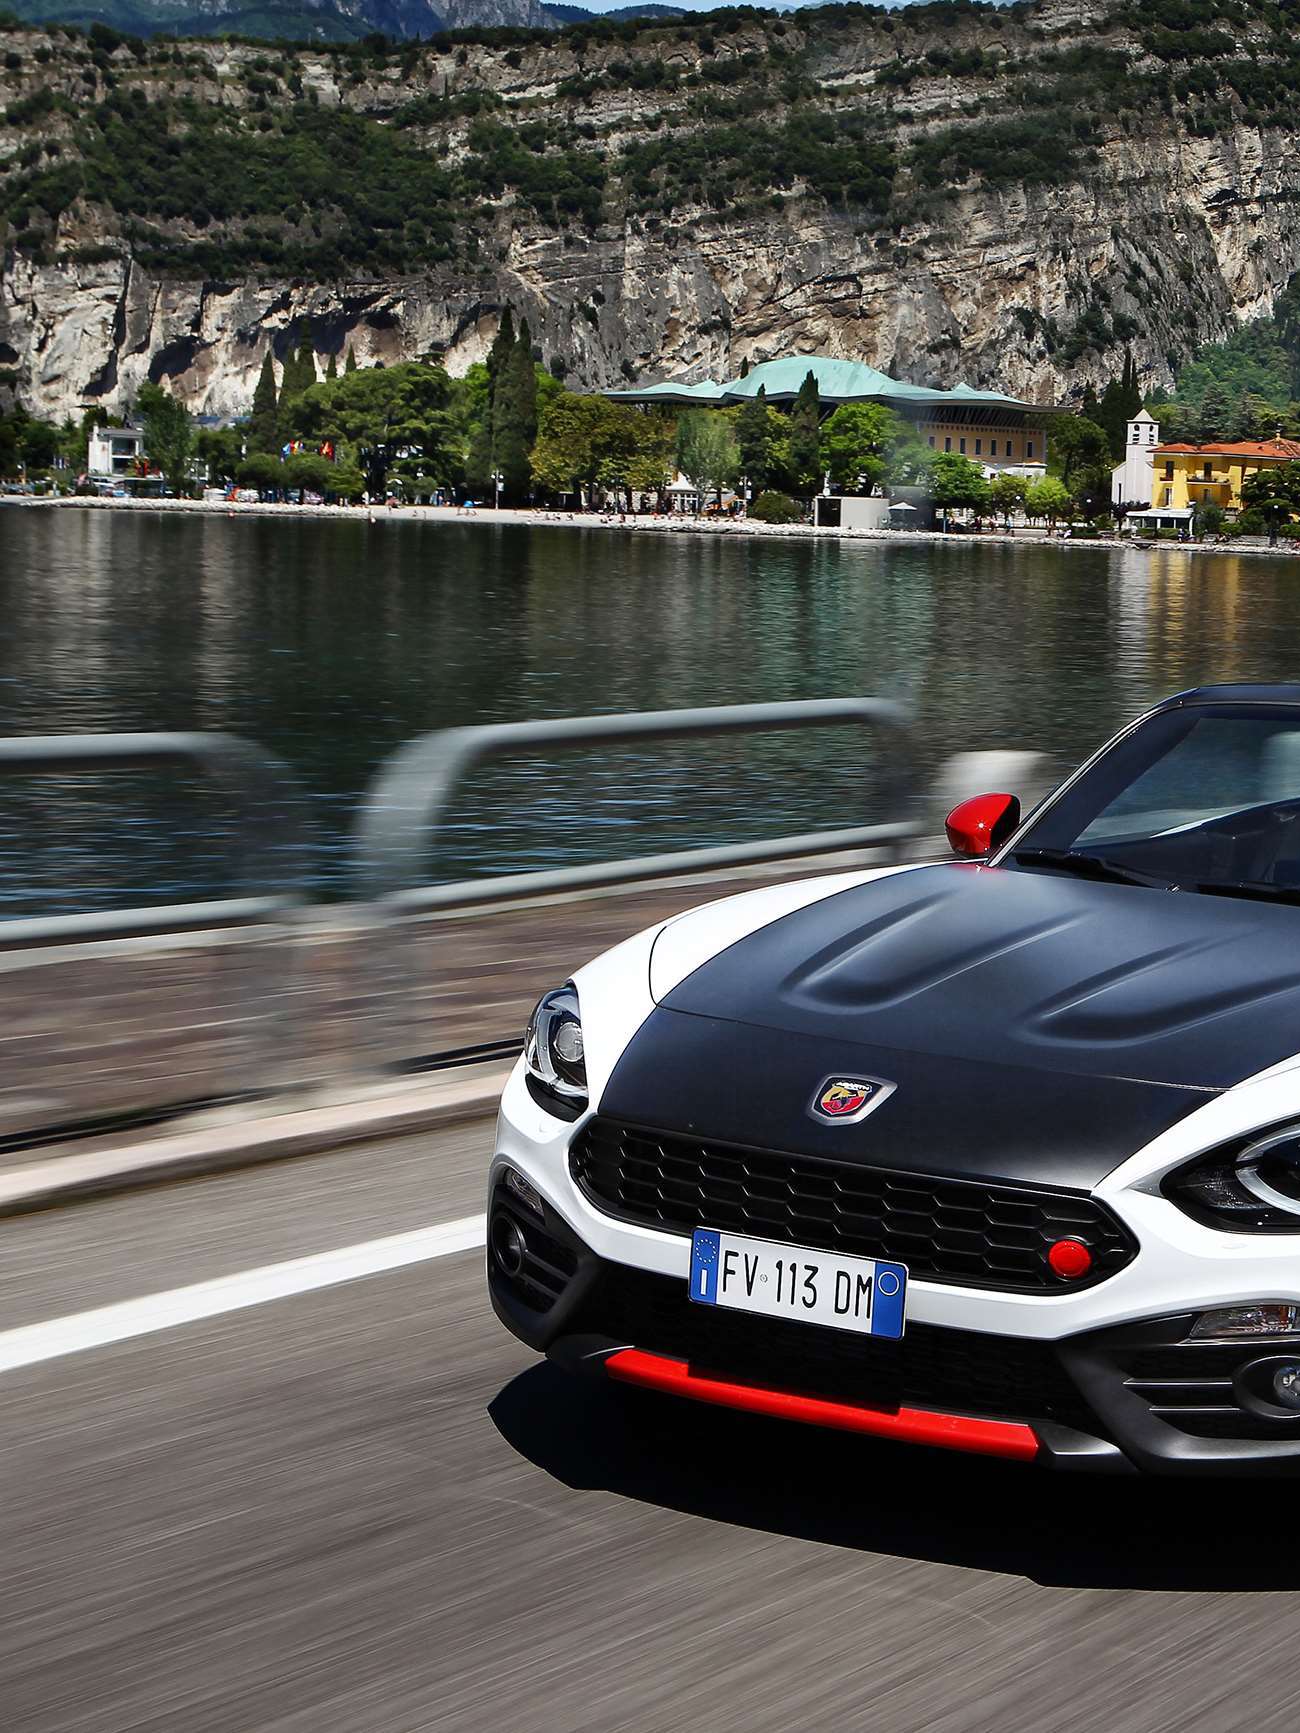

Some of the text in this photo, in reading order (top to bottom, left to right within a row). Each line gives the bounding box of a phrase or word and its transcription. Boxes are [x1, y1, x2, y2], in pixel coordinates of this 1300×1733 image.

[700, 1268, 708, 1295] I
[722, 1250, 873, 1320] FV 113 DM
